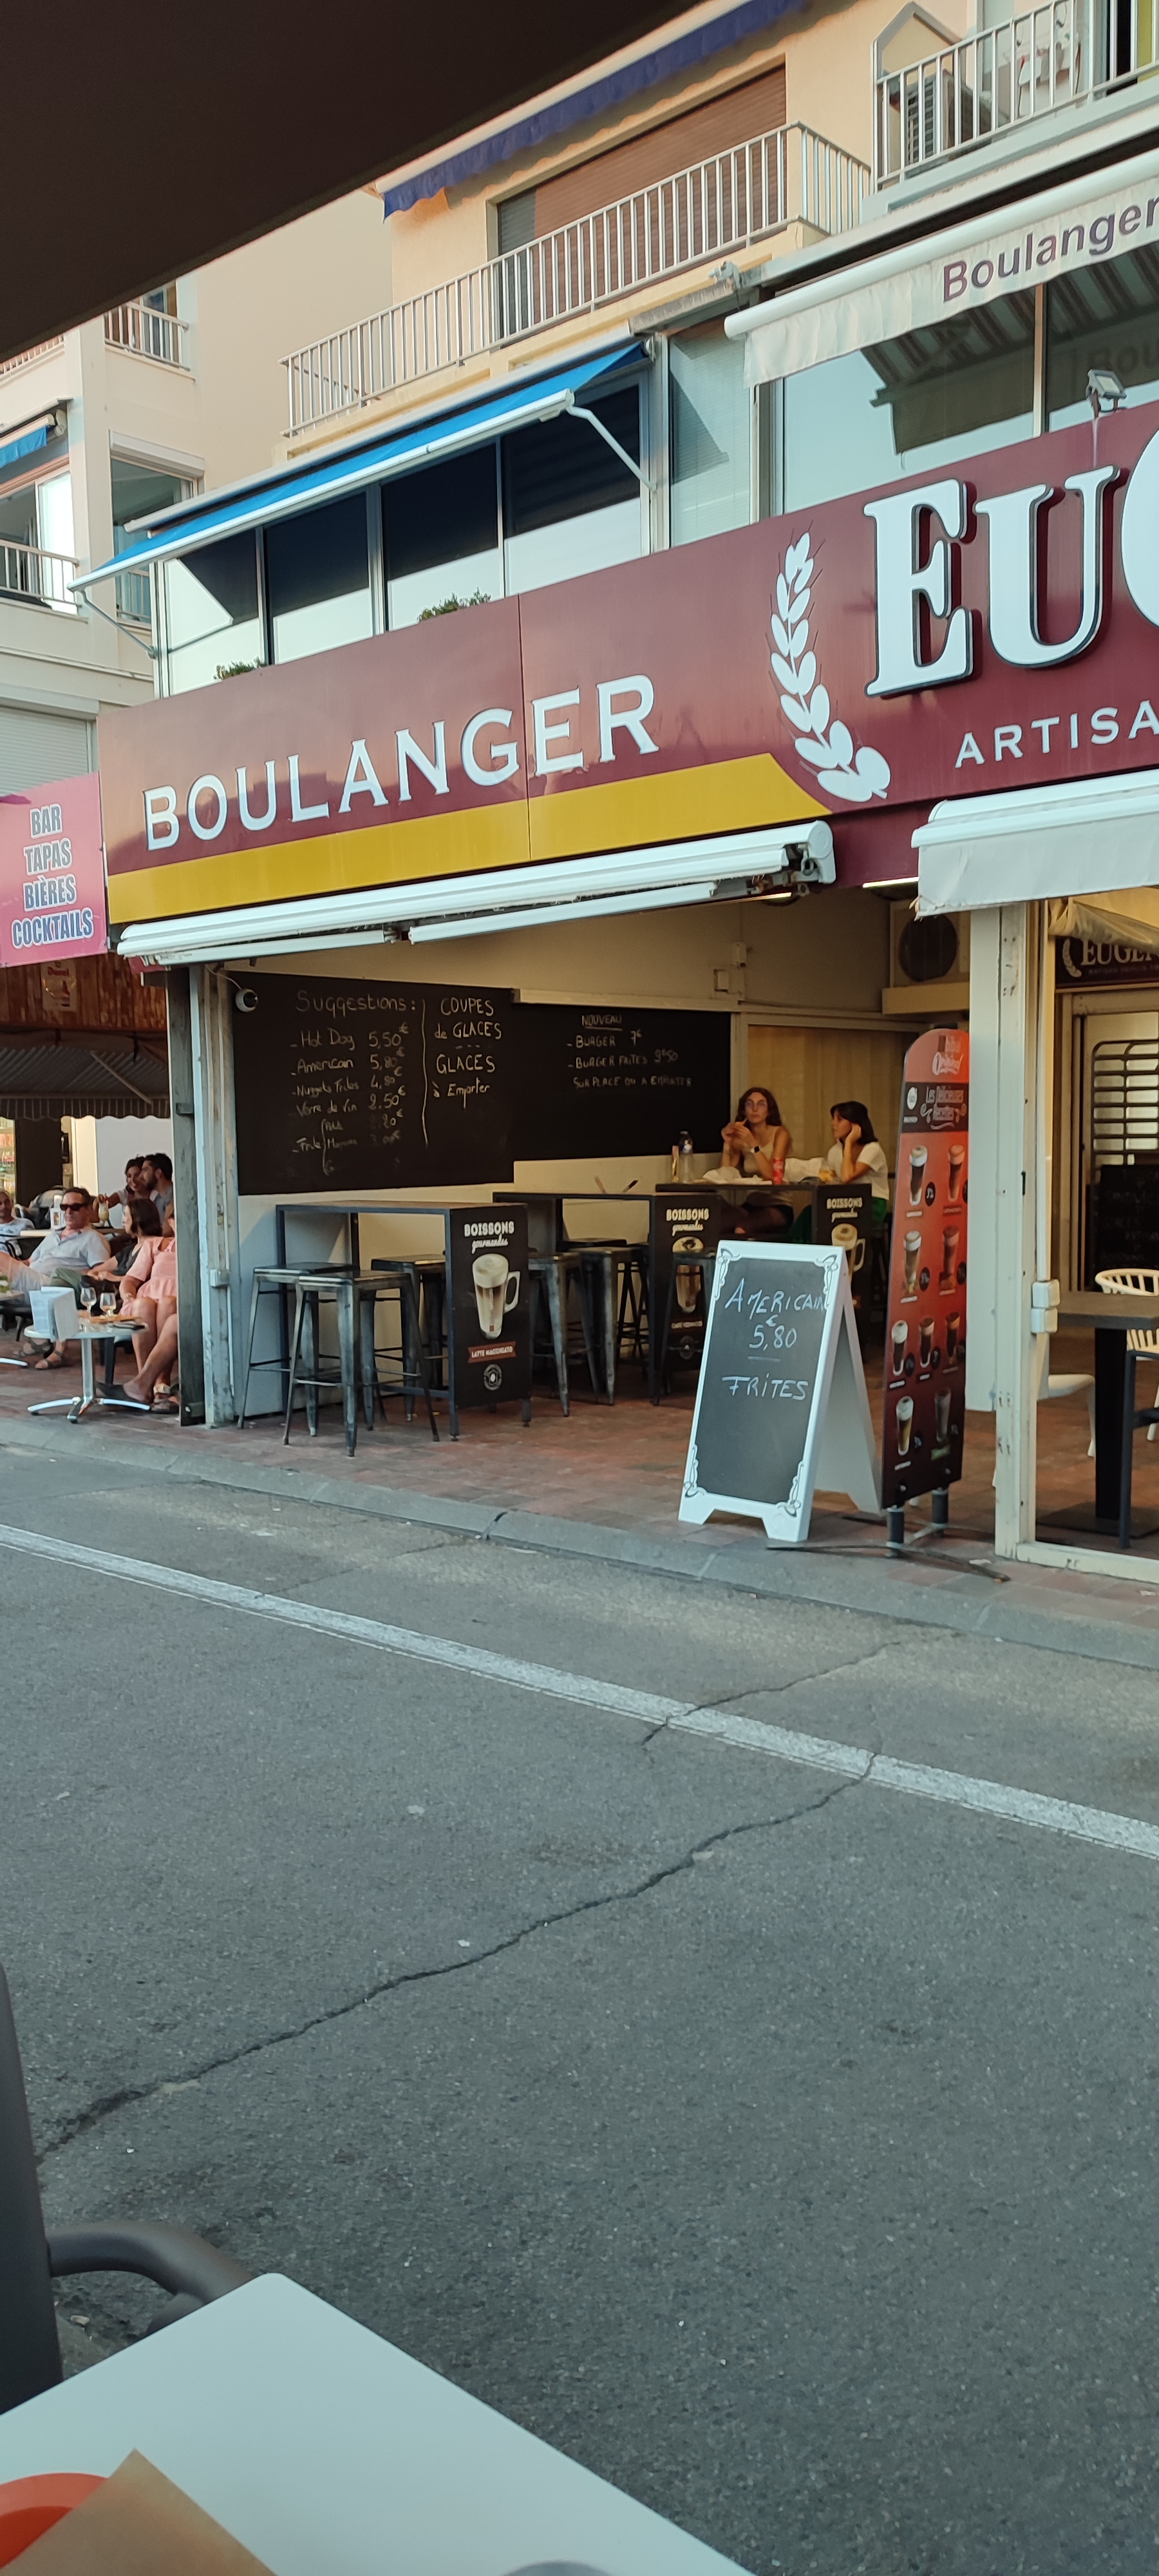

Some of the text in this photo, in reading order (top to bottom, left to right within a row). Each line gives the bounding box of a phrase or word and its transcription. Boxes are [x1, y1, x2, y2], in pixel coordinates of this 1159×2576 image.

[955, 699, 1159, 768] ARTISA
[142, 674, 659, 851] BOULANGER
[30, 804, 62, 838] BAR
[24, 837, 73, 875] TAPAS
[23, 873, 77, 912] BIÈRES
[12, 907, 93, 949] COCKTAILS
[440, 997, 494, 1016] COUPES
[435, 1021, 502, 1040] de GLACES
[581, 1014, 622, 1027] NOUVEAU
[301, 1030, 322, 1048] Hot
[329, 1028, 355, 1050] Dog
[436, 1054, 496, 1074] GLACES
[592, 1076, 621, 1088] PLACE
[666, 1208, 709, 1222] BOISSONS
[464, 1220, 514, 1237] BOISSONS
[722, 1373, 808, 1400] FRITES
